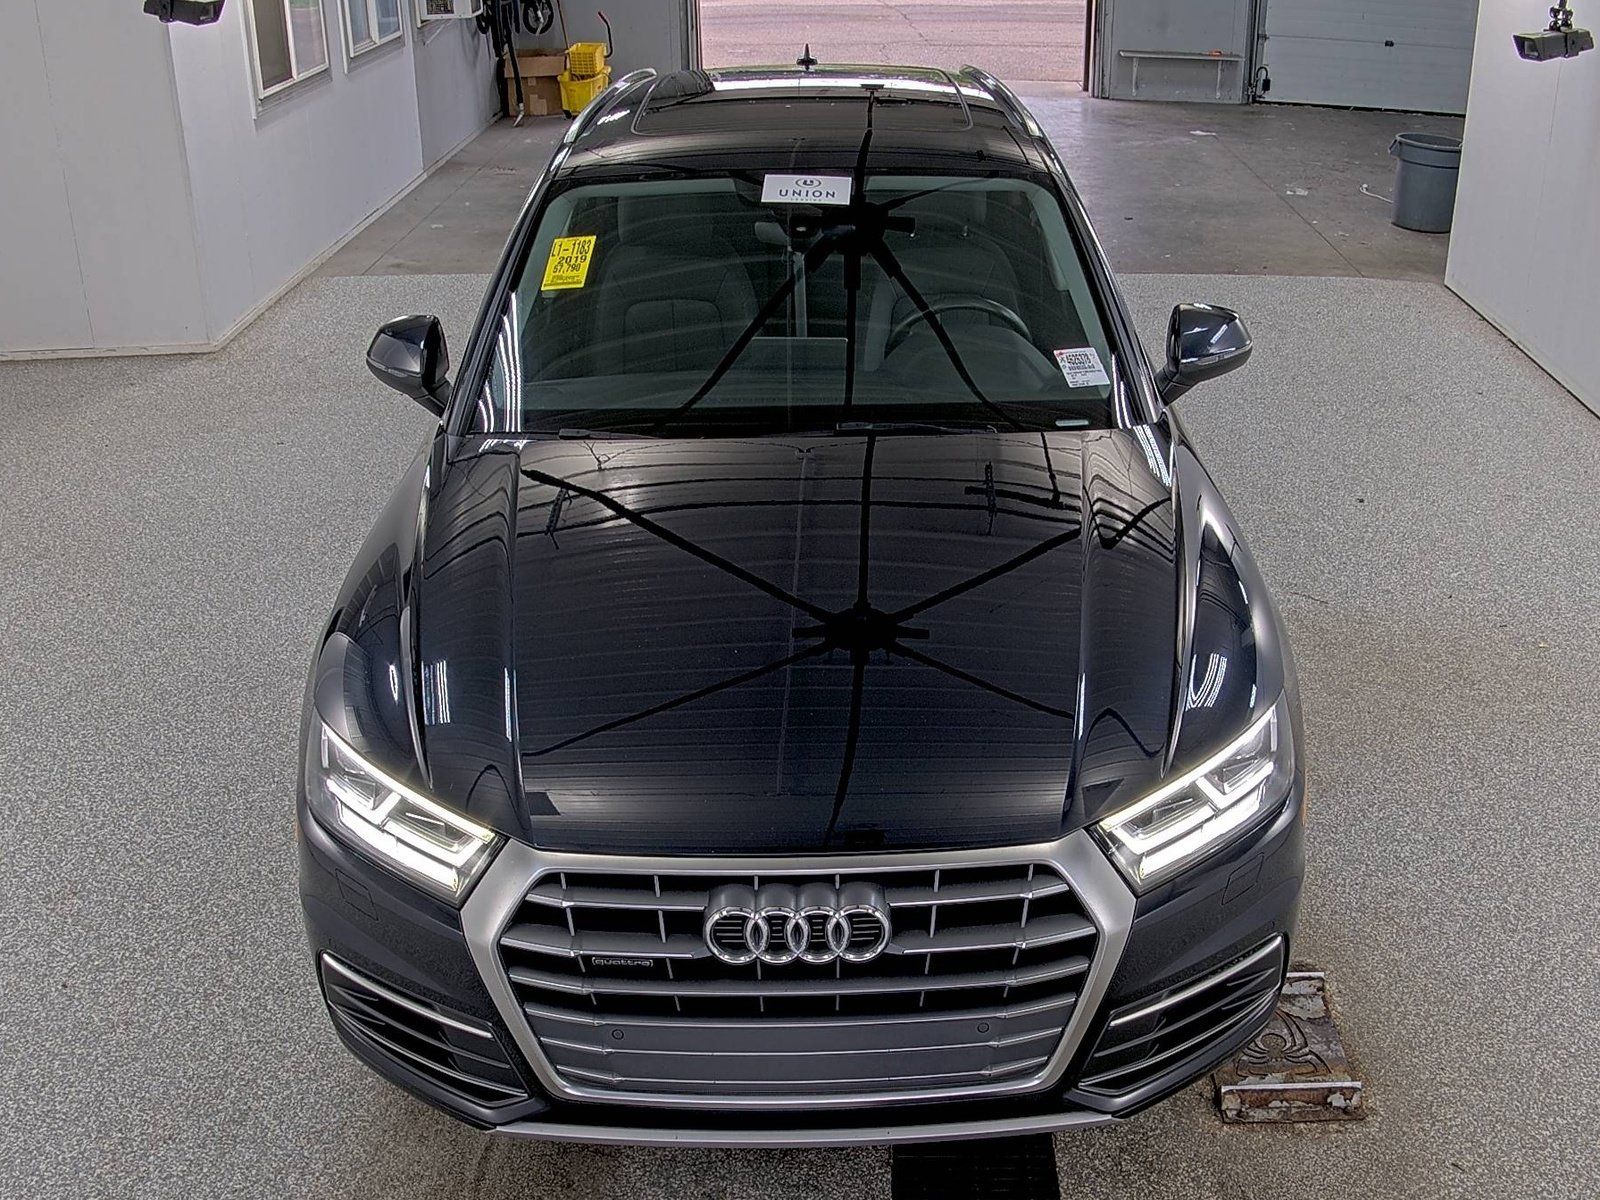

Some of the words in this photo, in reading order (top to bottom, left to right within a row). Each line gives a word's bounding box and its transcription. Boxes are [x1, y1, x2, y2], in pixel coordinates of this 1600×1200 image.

[779, 189, 835, 198] UNION
[558, 254, 587, 265] 2019
[595, 959, 650, 967] quattro
